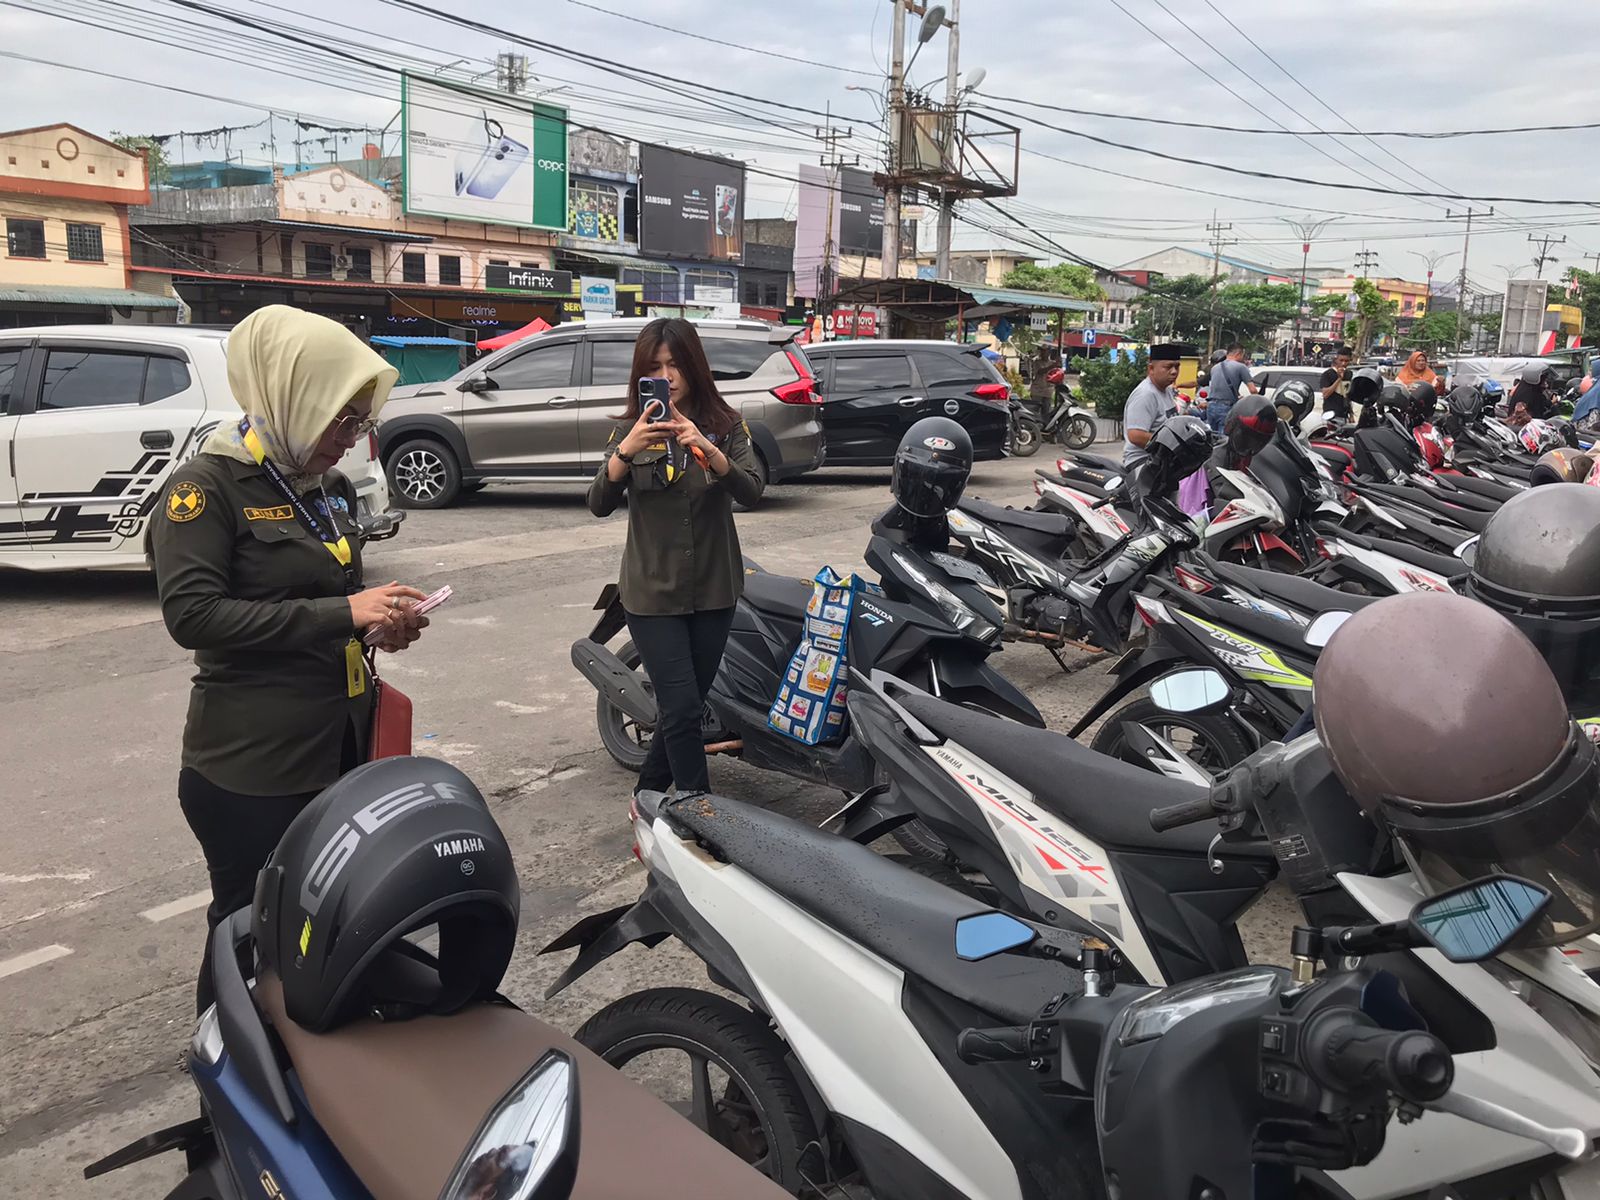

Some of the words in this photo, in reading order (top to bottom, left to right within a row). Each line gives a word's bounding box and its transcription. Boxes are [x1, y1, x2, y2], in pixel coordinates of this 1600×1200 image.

[644, 195, 671, 206] SAMSUNG
[508, 271, 554, 288] Infinix
[462, 305, 497, 317] realme
[278, 479, 297, 503] TANJUNG
[295, 501, 312, 522] SAMSAT
[860, 599, 894, 624] HONDA
[935, 749, 962, 770] YAMAHA
[433, 837, 485, 858] YAMAHA
[1040, 826, 1093, 862] 125
